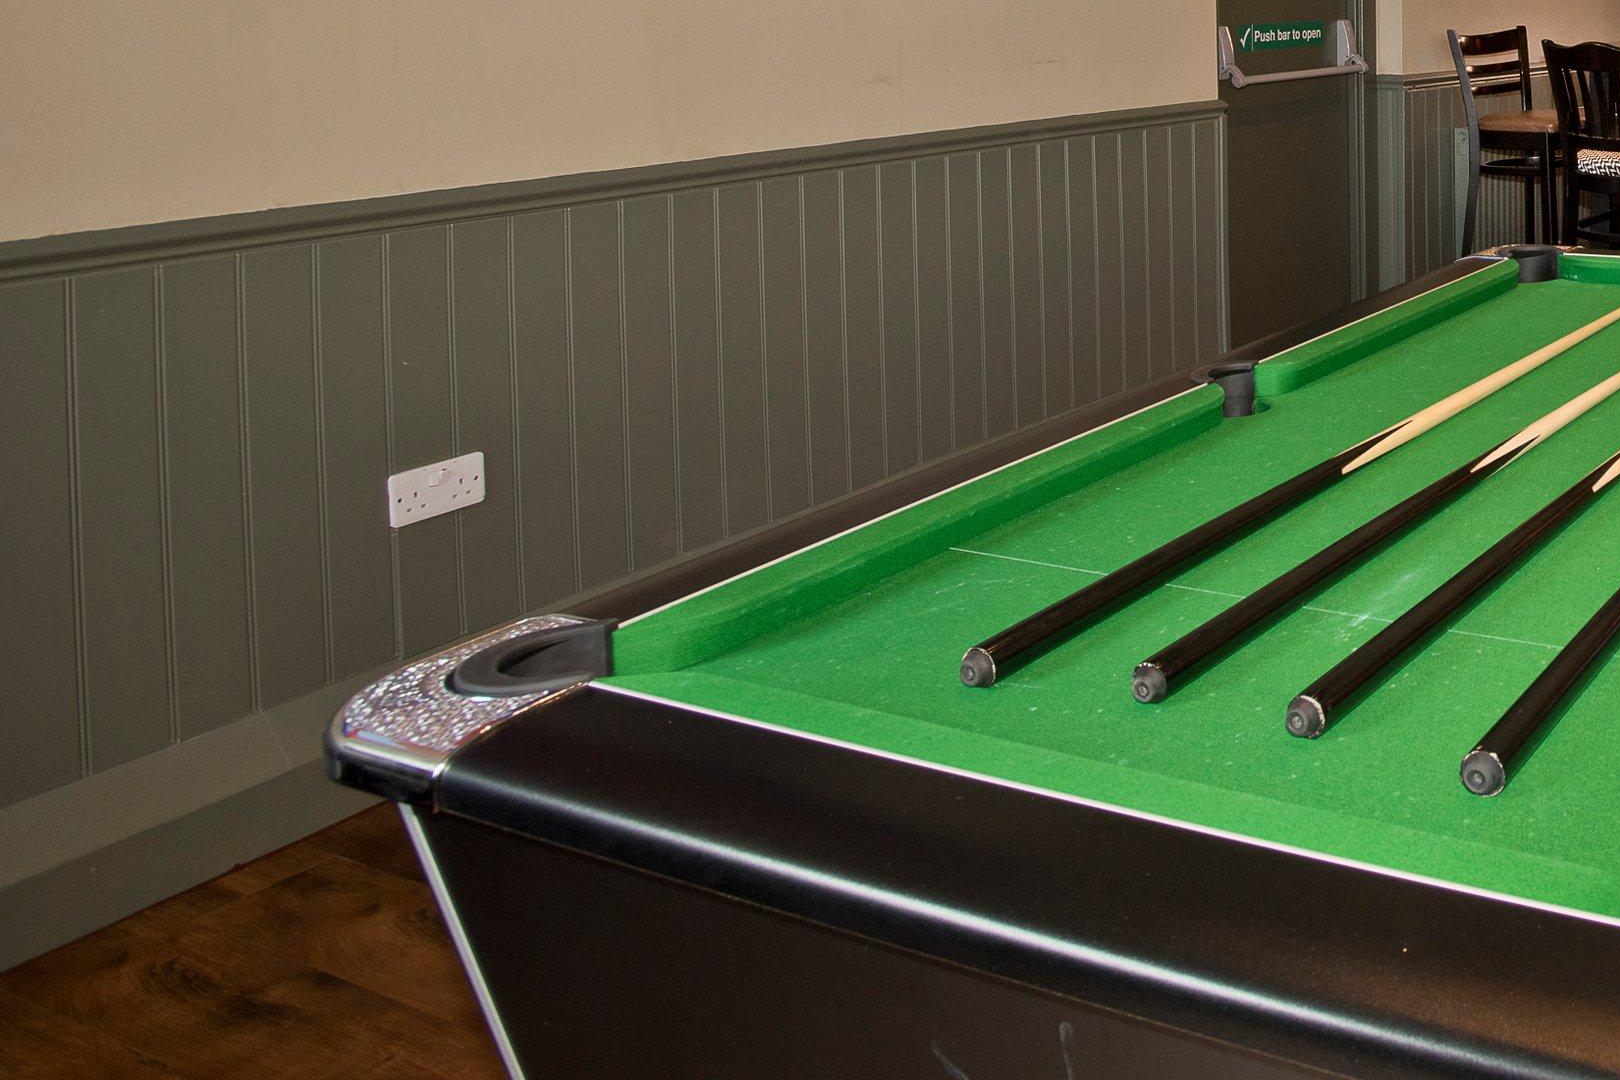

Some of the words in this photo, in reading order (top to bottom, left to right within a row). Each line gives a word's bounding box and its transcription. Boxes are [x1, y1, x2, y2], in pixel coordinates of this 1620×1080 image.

[1254, 30, 1275, 43] Push
[1277, 29, 1290, 41] bar
[1292, 29, 1300, 40] to
[1301, 29, 1322, 42] open
